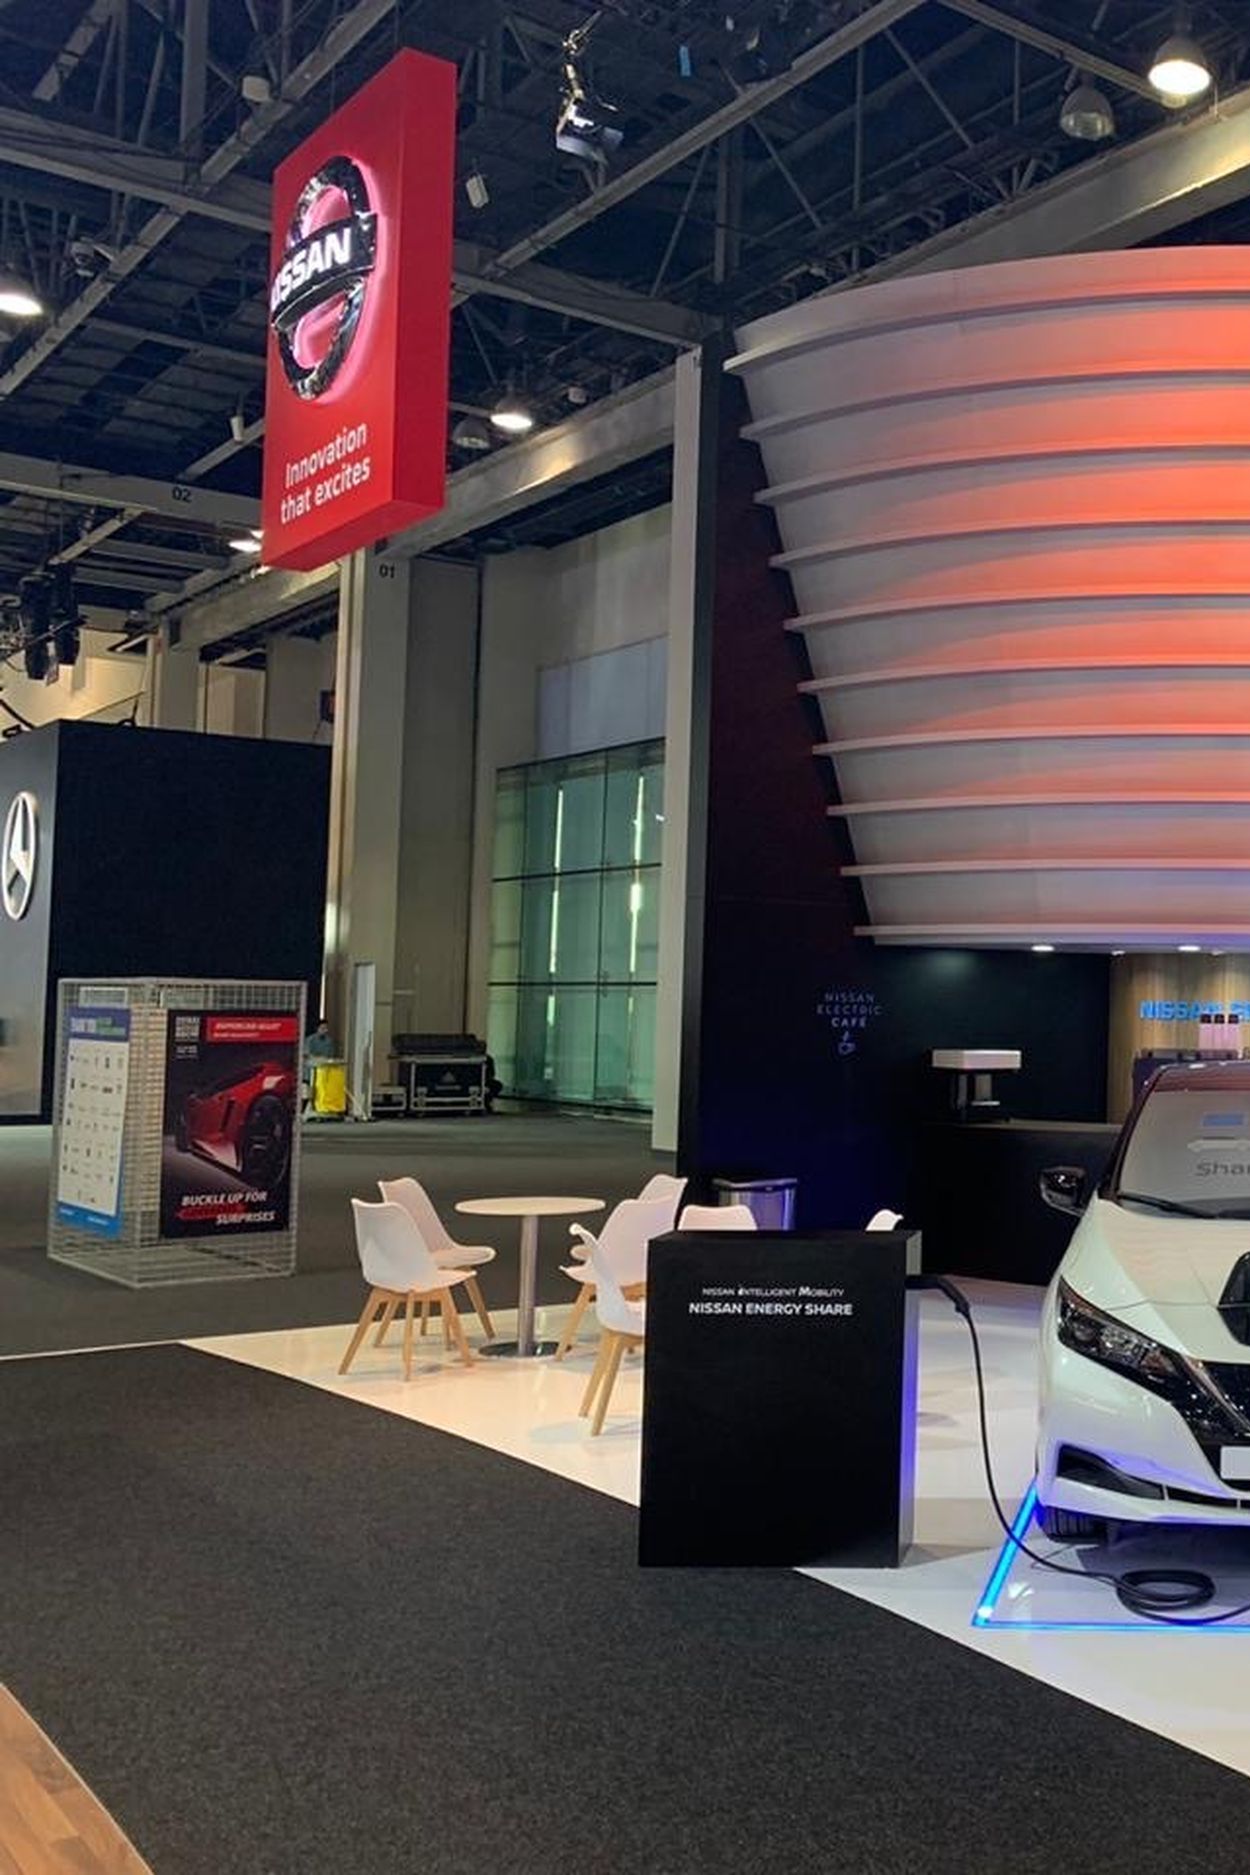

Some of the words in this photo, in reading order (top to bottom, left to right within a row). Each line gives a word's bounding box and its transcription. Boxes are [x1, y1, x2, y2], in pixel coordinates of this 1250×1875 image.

[271, 227, 352, 313] ISSAN
[285, 422, 367, 490] Innovation
[172, 486, 192, 504] 02
[281, 486, 311, 524] that
[315, 456, 371, 507] excites
[379, 562, 396, 579] 01
[702, 1287, 735, 1297] NISSAN
[799, 1286, 845, 1297] MOBILITY
[689, 1302, 743, 1315] NISSAN
[745, 1303, 802, 1316] ENERGY
[804, 1303, 853, 1317] SHARE
